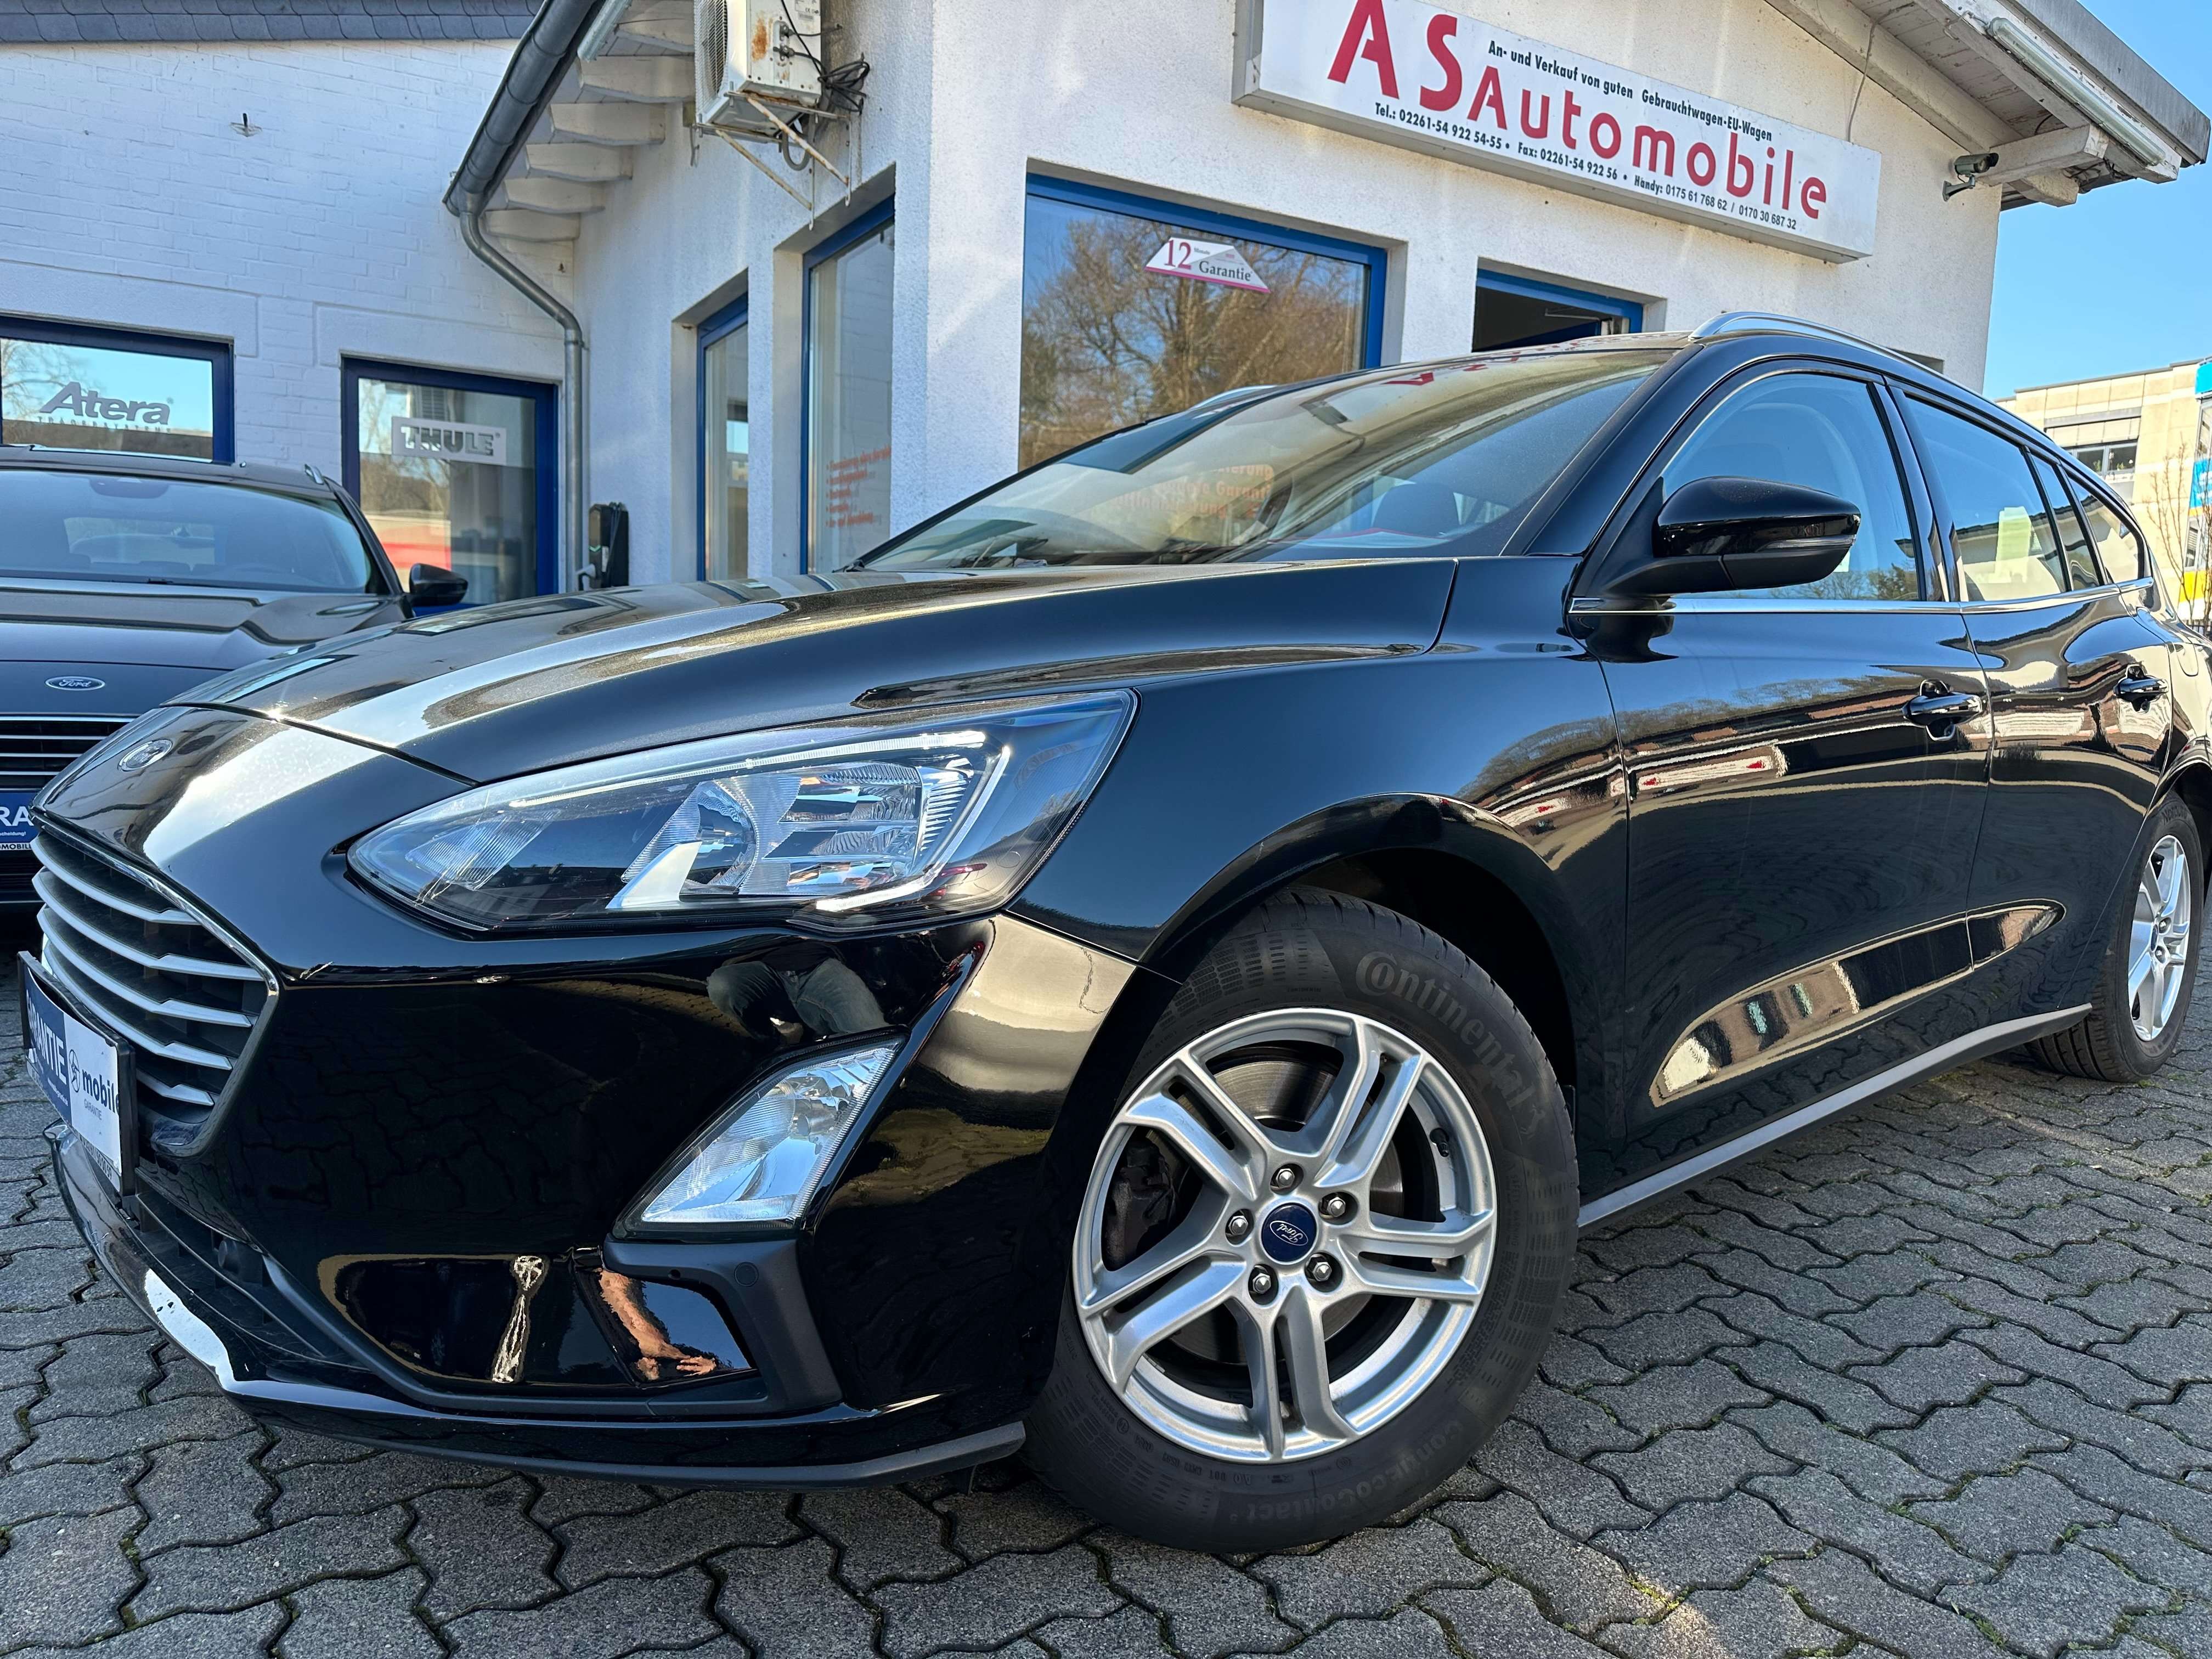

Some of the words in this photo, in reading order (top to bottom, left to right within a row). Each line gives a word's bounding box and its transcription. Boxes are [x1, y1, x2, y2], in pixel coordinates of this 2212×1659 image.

[1488, 40, 1507, 57] An-
[1511, 49, 1531, 66] und
[1535, 54, 1578, 81] Verkauf
[1581, 73, 1600, 88] von
[1604, 80, 1633, 99] guten
[1642, 89, 1772, 142] Gebrauchtwagen-EU-Wagen
[1375, 102, 1396, 119] Tel.:
[1400, 109, 1448, 134] 02261-54
[1452, 125, 1471, 140] 922
[1474, 131, 1502, 149] 54-55
[1518, 142, 1537, 157] Fax:
[1541, 149, 1584, 171] 02261-54
[1587, 162, 1604, 177] 922
[1606, 167, 1617, 180] 56
[1666, 184, 1686, 199] 0175
[1688, 190, 1697, 202] 61
[1701, 194, 1715, 207] 768
[1717, 199, 1727, 211] 62
[1739, 205, 1758, 219] 0170
[1760, 211, 1769, 223] 30
[1771, 213, 1785, 227] 687
[1787, 219, 1797, 230] 32
[1164, 239, 1192, 270] 12
[1199, 260, 1251, 281] Garantie
[39, 381, 171, 425] Atera
[400, 426, 494, 456] THULE
[59, 679, 92, 687] Ford
[1356, 951, 1536, 1111] Continental
[1276, 1223, 1304, 1243] Ford
